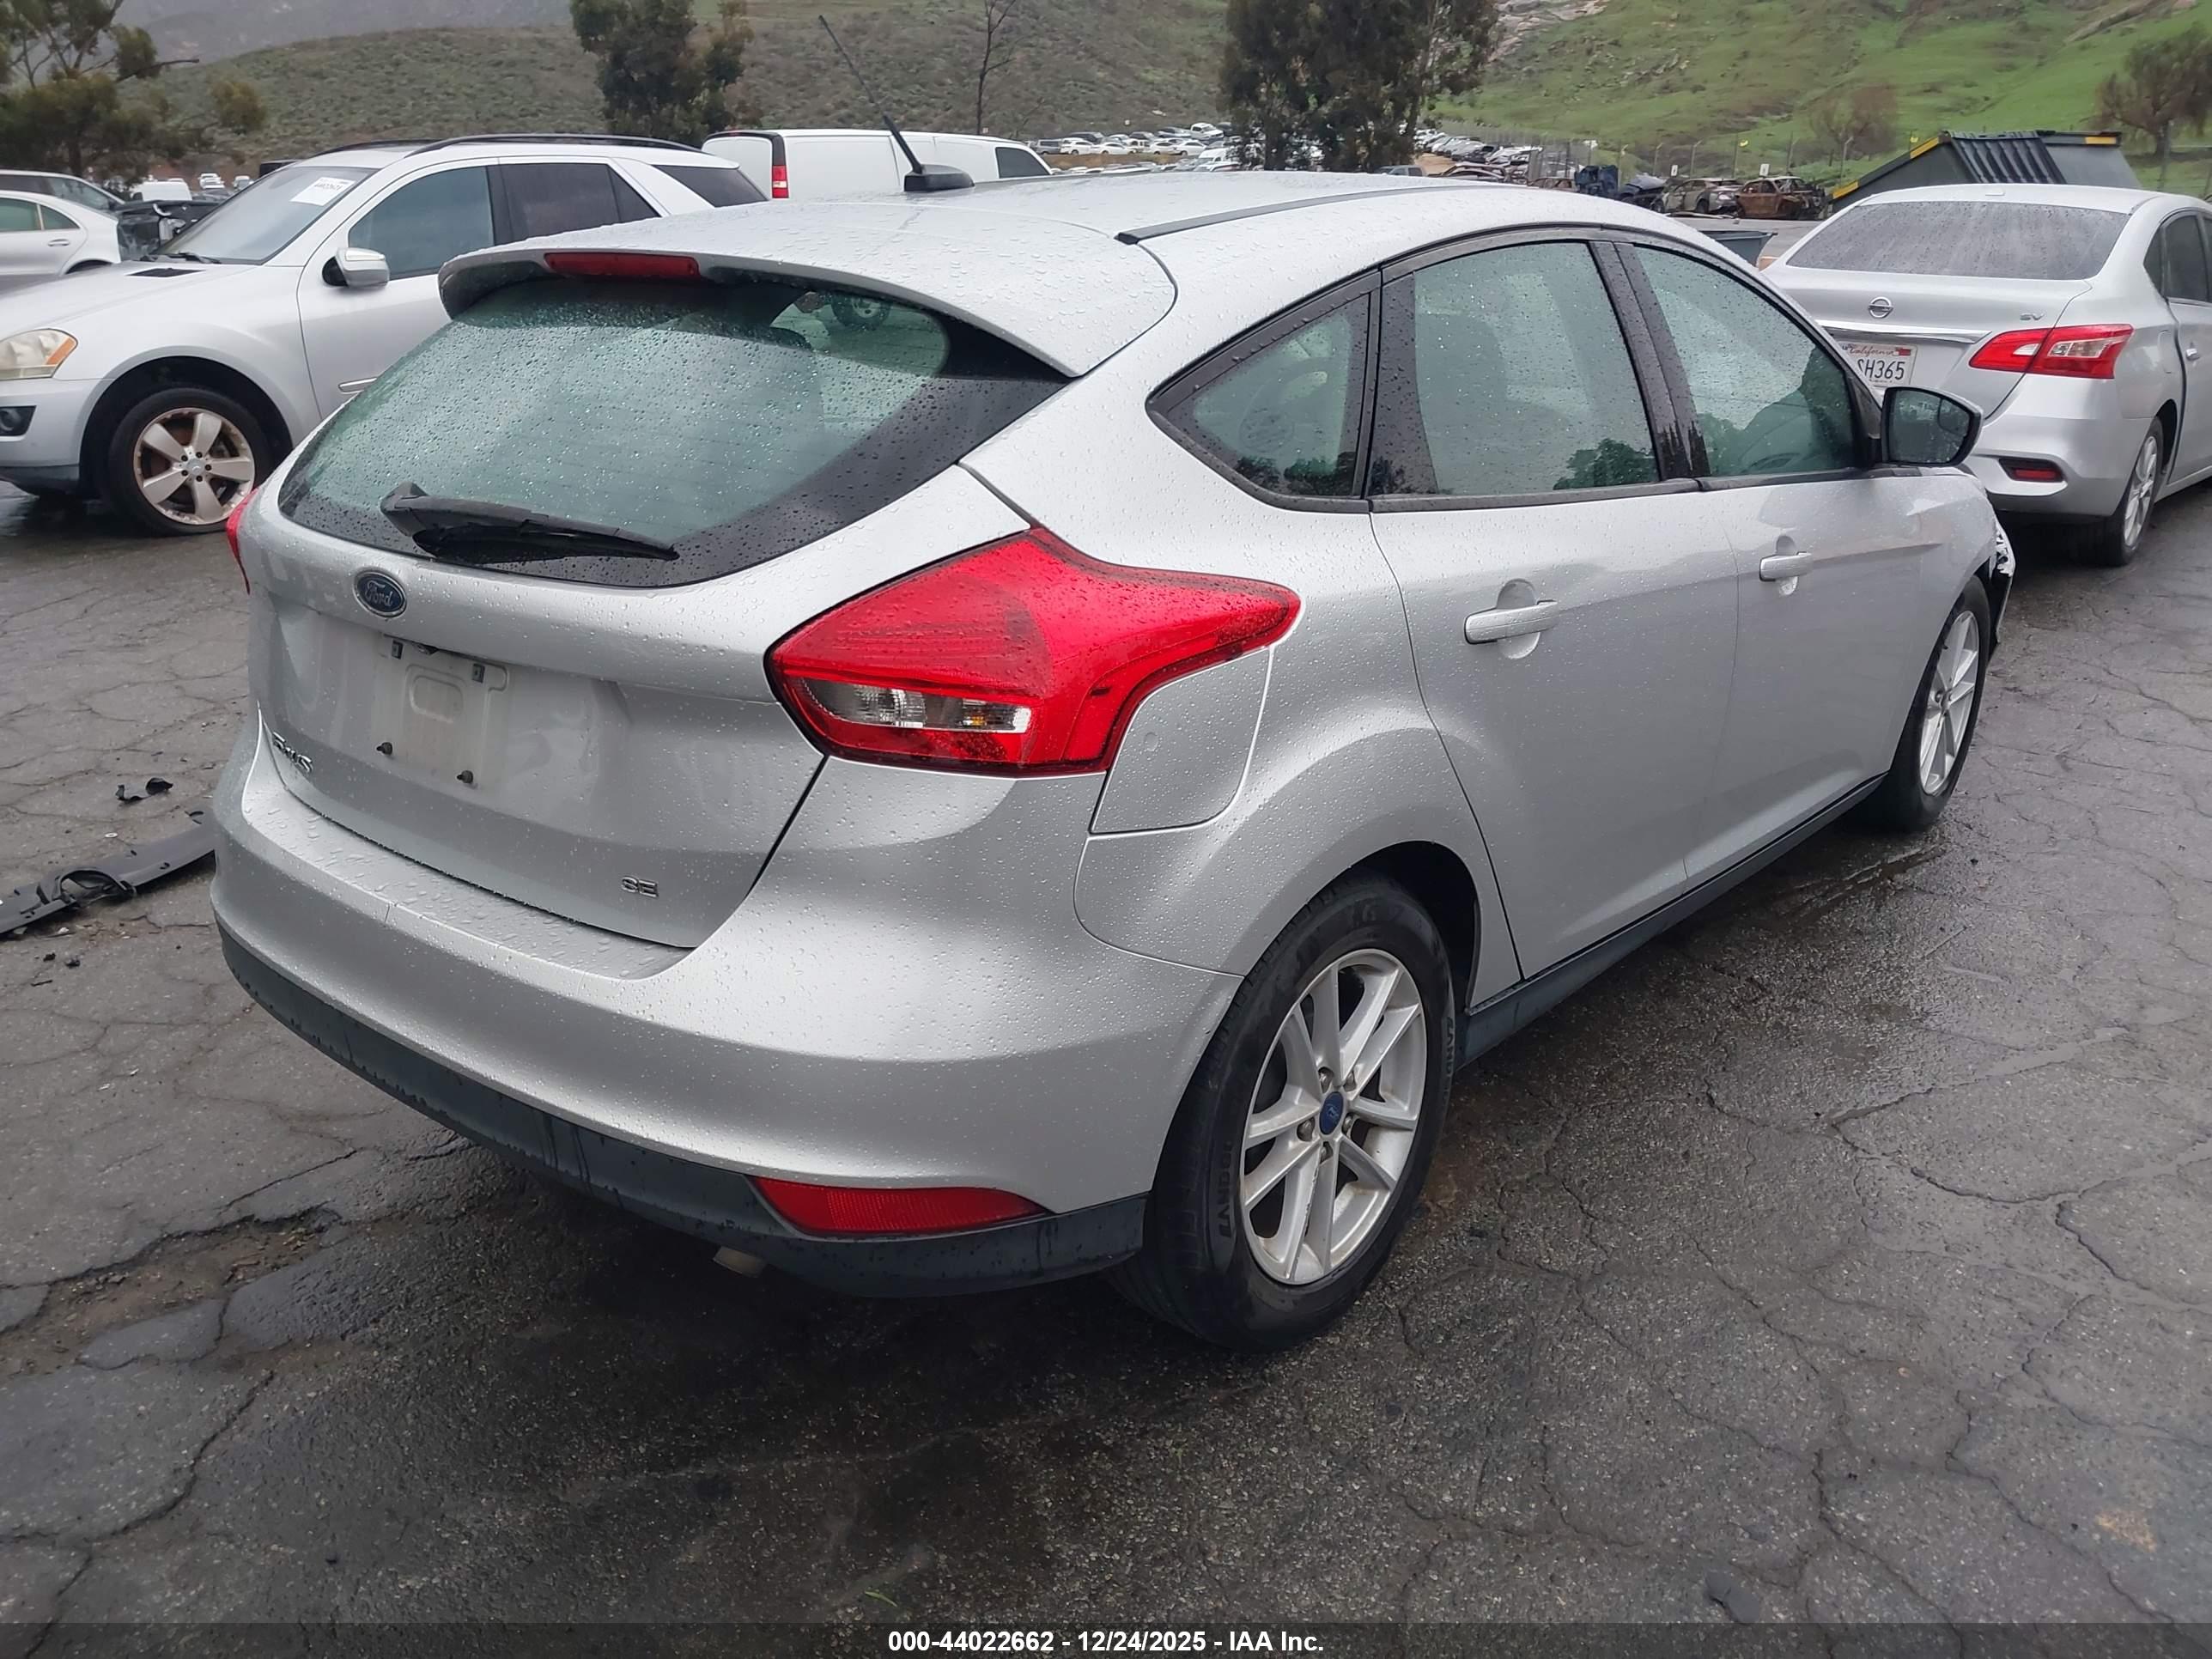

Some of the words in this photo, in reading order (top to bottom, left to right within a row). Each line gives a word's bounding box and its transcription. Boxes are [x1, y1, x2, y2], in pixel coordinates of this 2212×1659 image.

[2020, 313, 2045, 321] SV
[365, 580, 393, 607] Ford
[622, 877, 657, 897] SE
